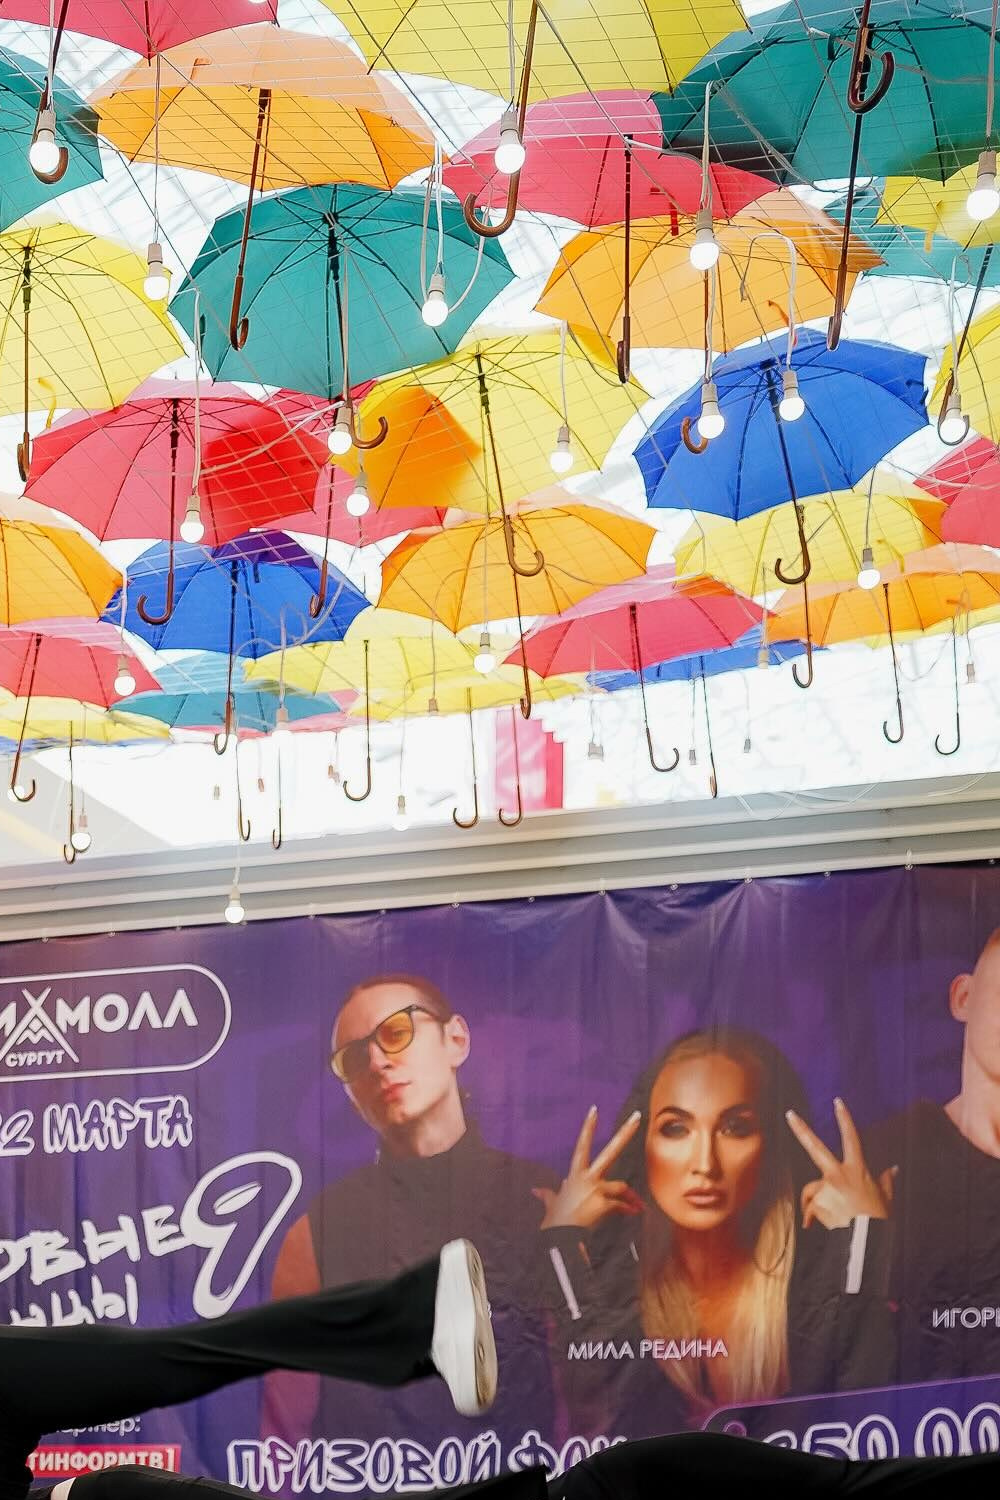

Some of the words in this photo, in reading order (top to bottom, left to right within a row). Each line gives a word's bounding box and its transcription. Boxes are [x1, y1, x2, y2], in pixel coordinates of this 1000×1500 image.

[5, 1049, 67, 1068] СУРГУТ
[43, 1094, 193, 1154] МАРТА
[567, 1339, 635, 1361] МИЛА
[639, 1337, 729, 1361] РЕДИНА
[226, 1429, 502, 1494] ПРИЗОВОЙ
[507, 1429, 628, 1482] ФО
